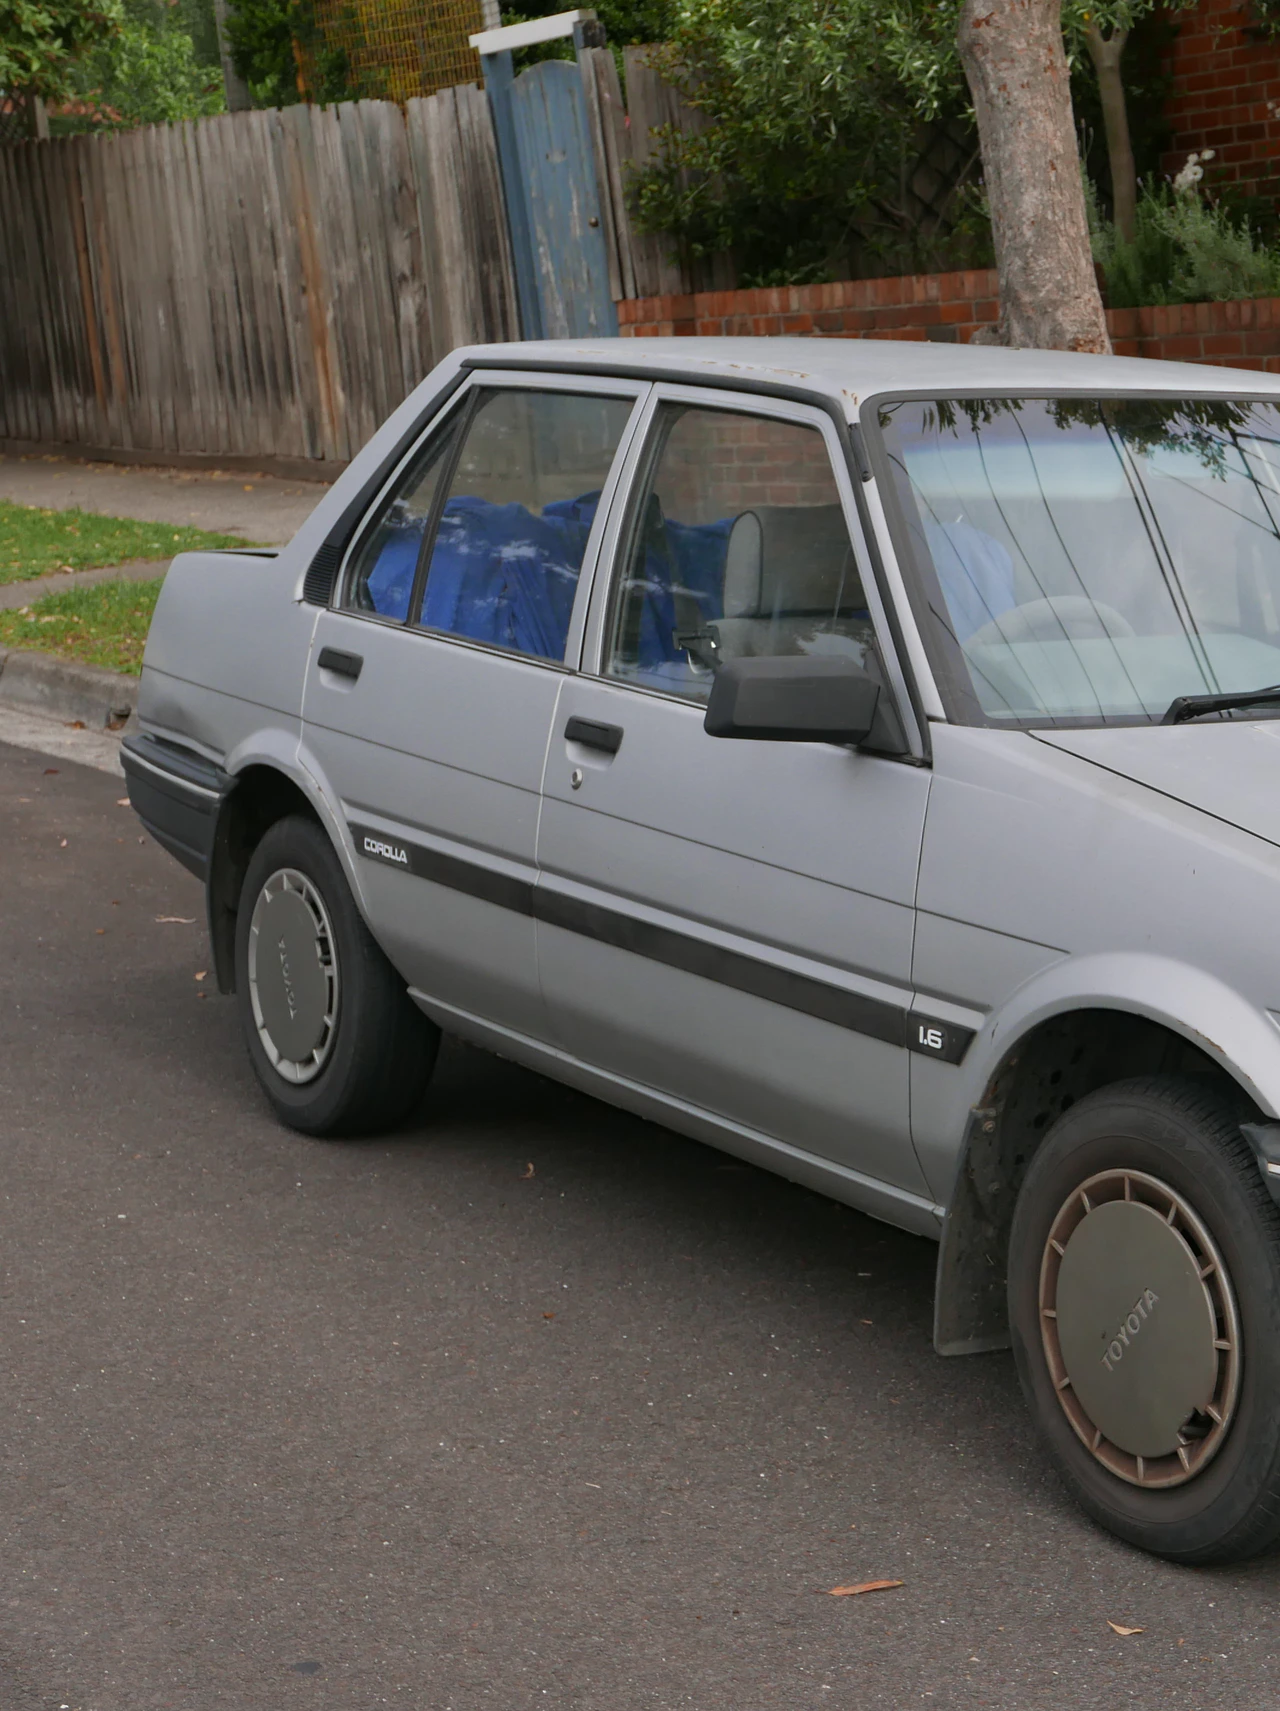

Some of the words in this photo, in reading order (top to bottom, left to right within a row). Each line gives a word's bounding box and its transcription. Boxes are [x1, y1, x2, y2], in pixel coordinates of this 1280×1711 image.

[364, 836, 408, 864] COROLLA
[919, 1025, 943, 1049] 1.6
[1101, 1287, 1160, 1373] TOYOTA
